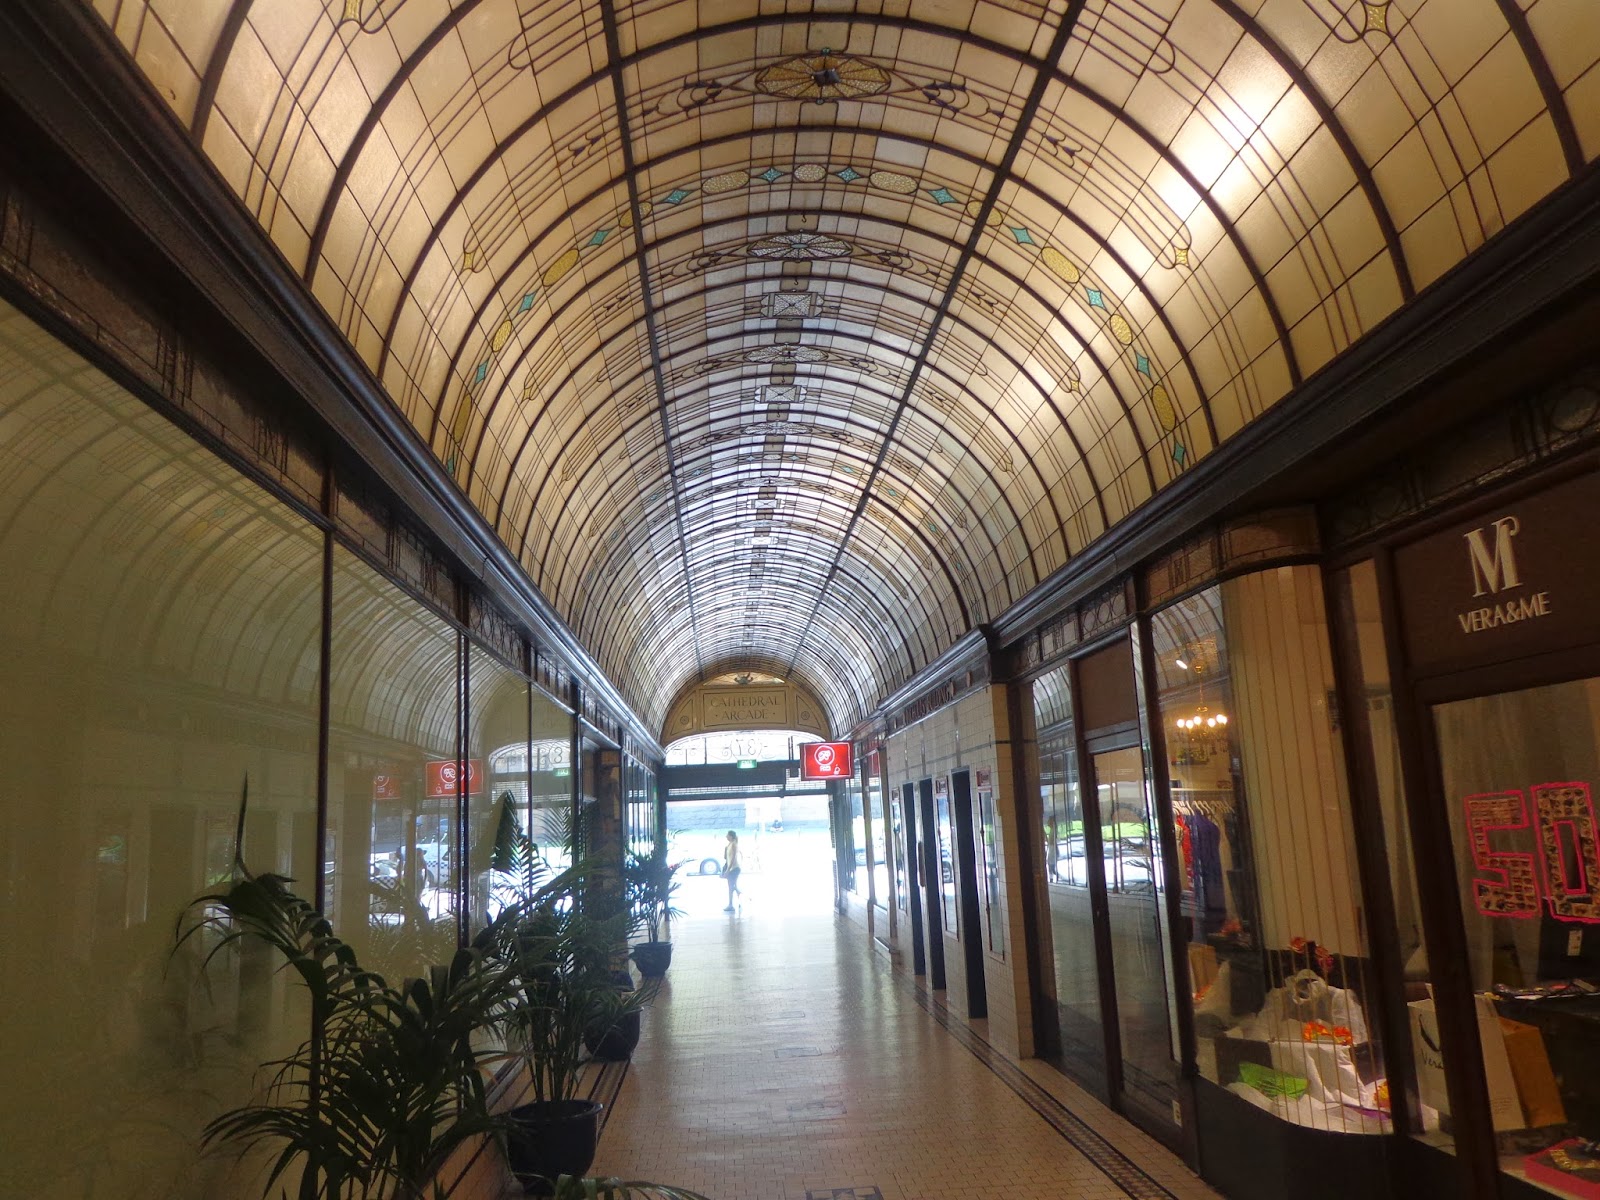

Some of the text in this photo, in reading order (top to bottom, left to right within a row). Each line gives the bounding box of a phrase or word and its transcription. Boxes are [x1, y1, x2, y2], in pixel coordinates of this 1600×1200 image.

[1458, 591, 1552, 634] VERA&ME
[710, 695, 781, 708] CATHEDRAL
[722, 708, 769, 721] ARCADE
